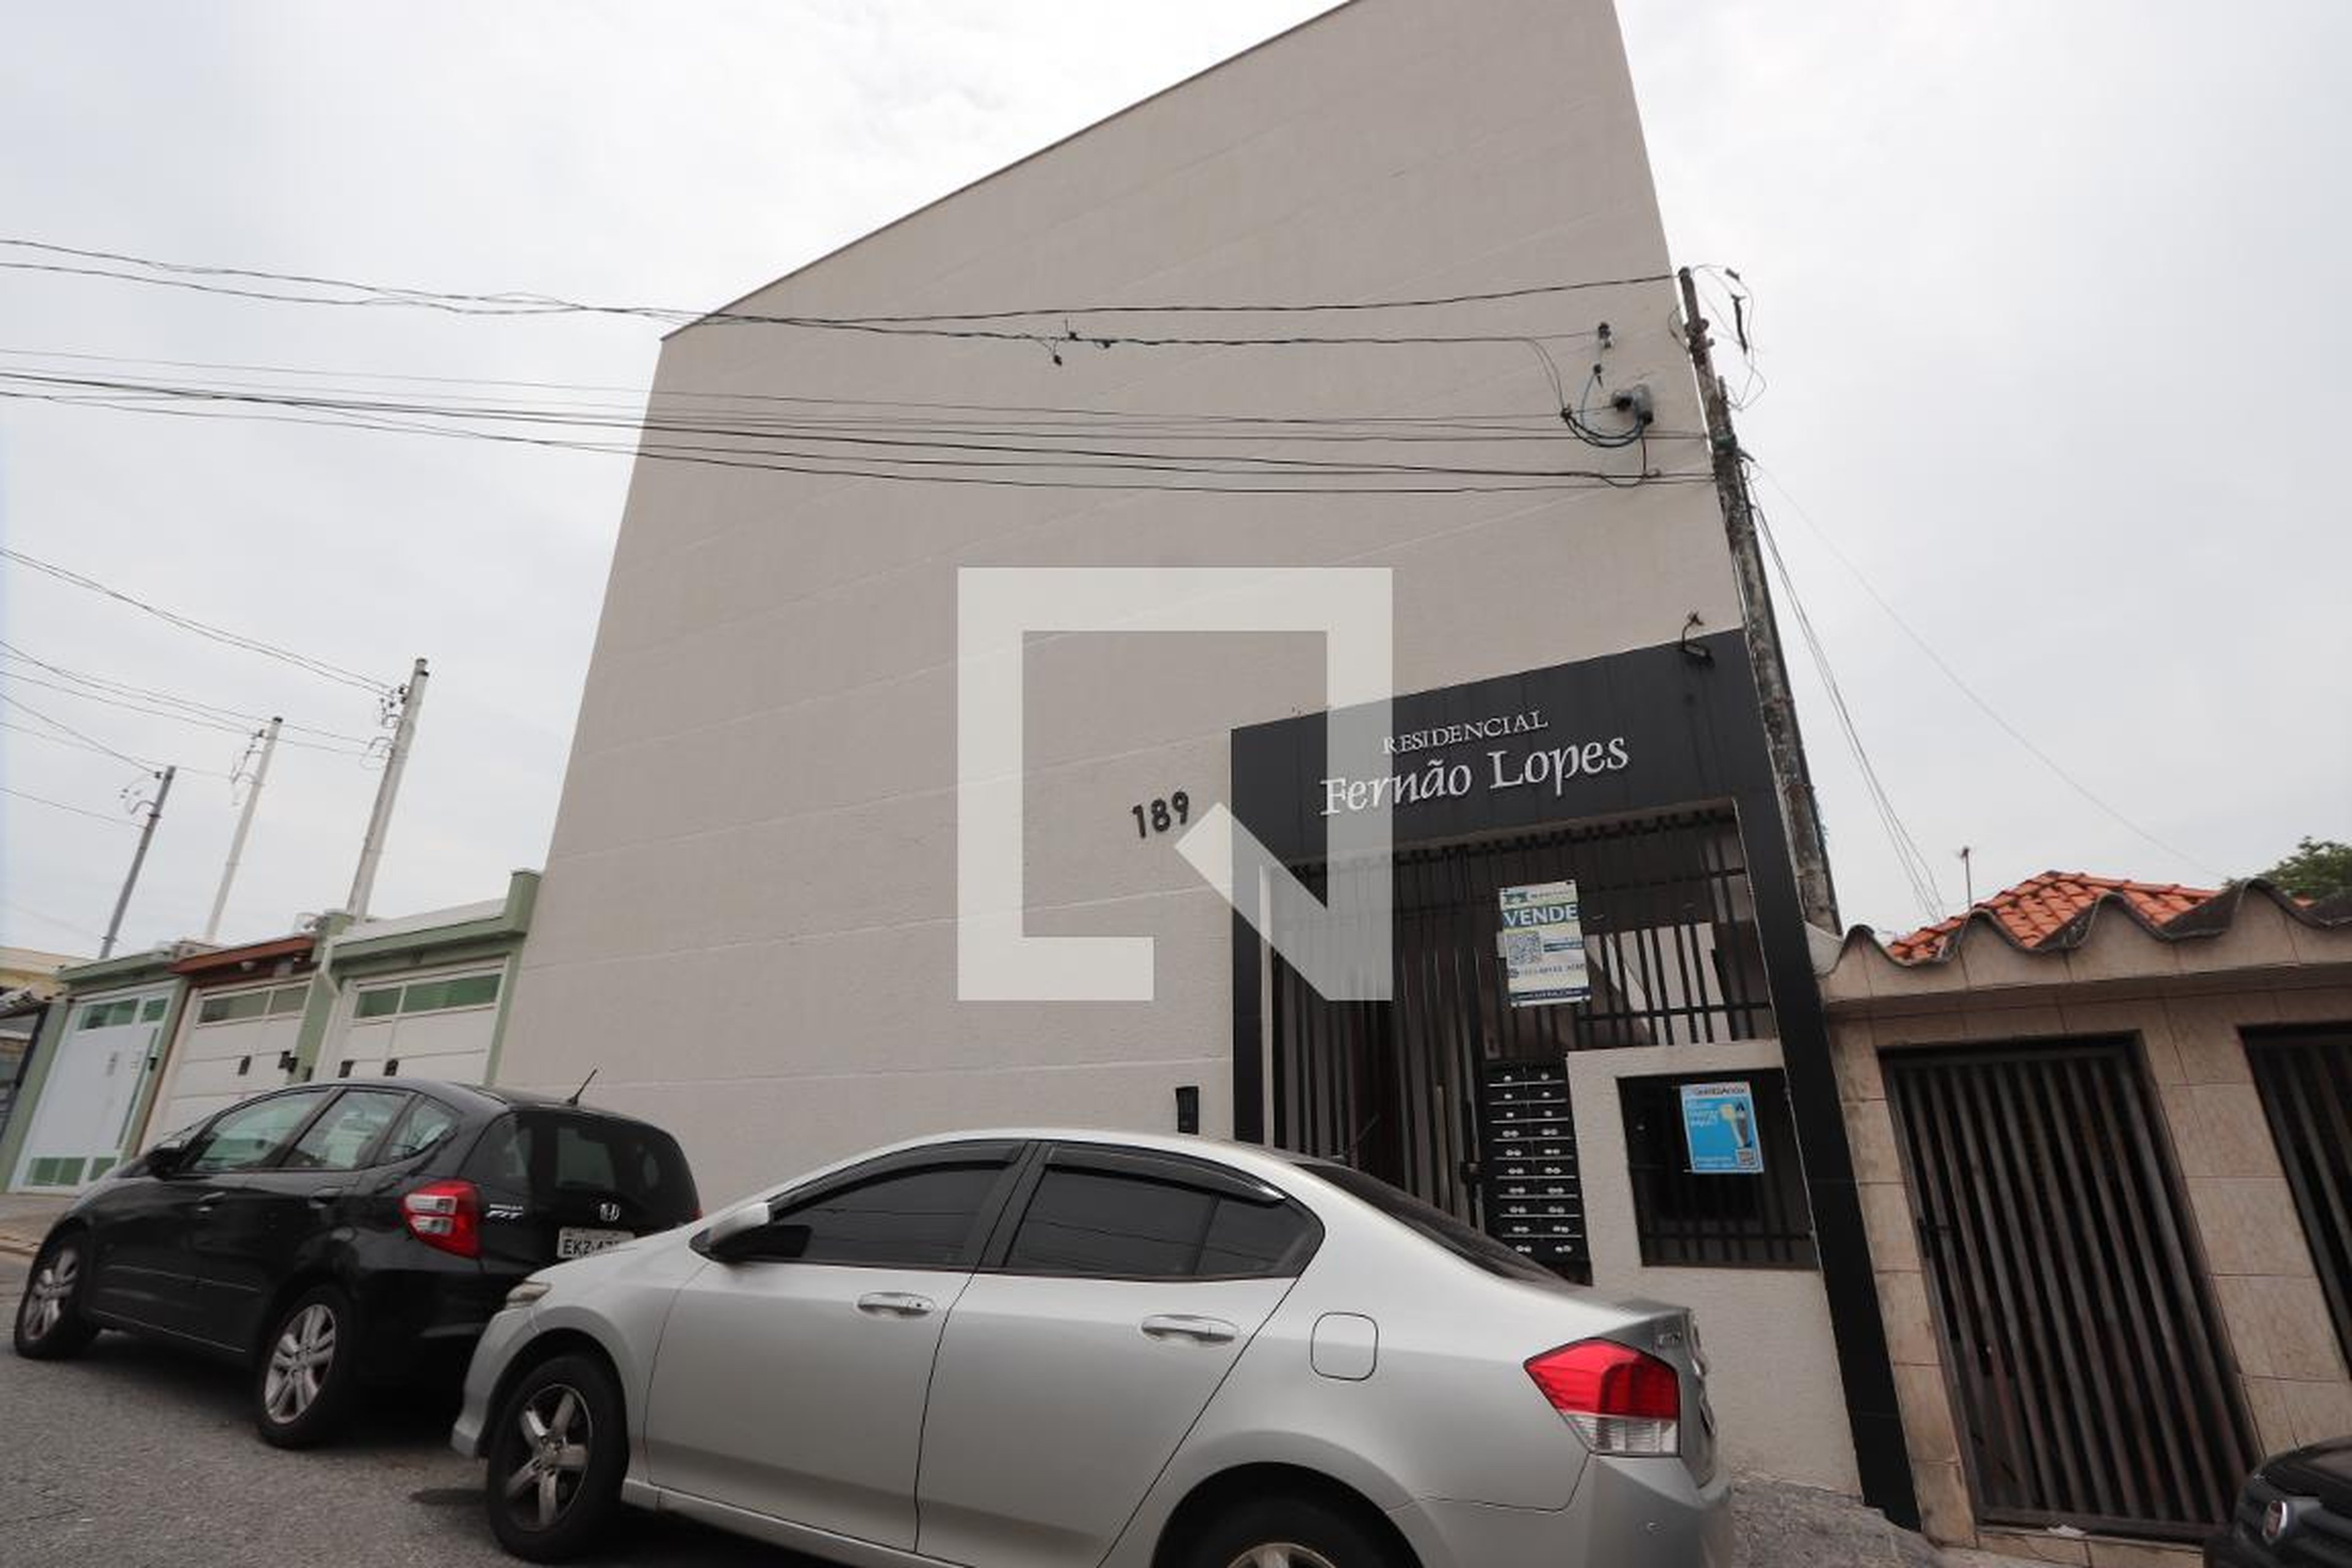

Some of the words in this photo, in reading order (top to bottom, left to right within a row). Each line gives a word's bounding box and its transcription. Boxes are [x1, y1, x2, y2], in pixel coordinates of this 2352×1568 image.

[1382, 710, 1548, 755] RESIDENCIAL
[1319, 760, 1472, 816] Fernão
[1487, 737, 1629, 796] Lopes
[1132, 791, 1189, 839] 189
[1504, 905, 1578, 927] VENDE
